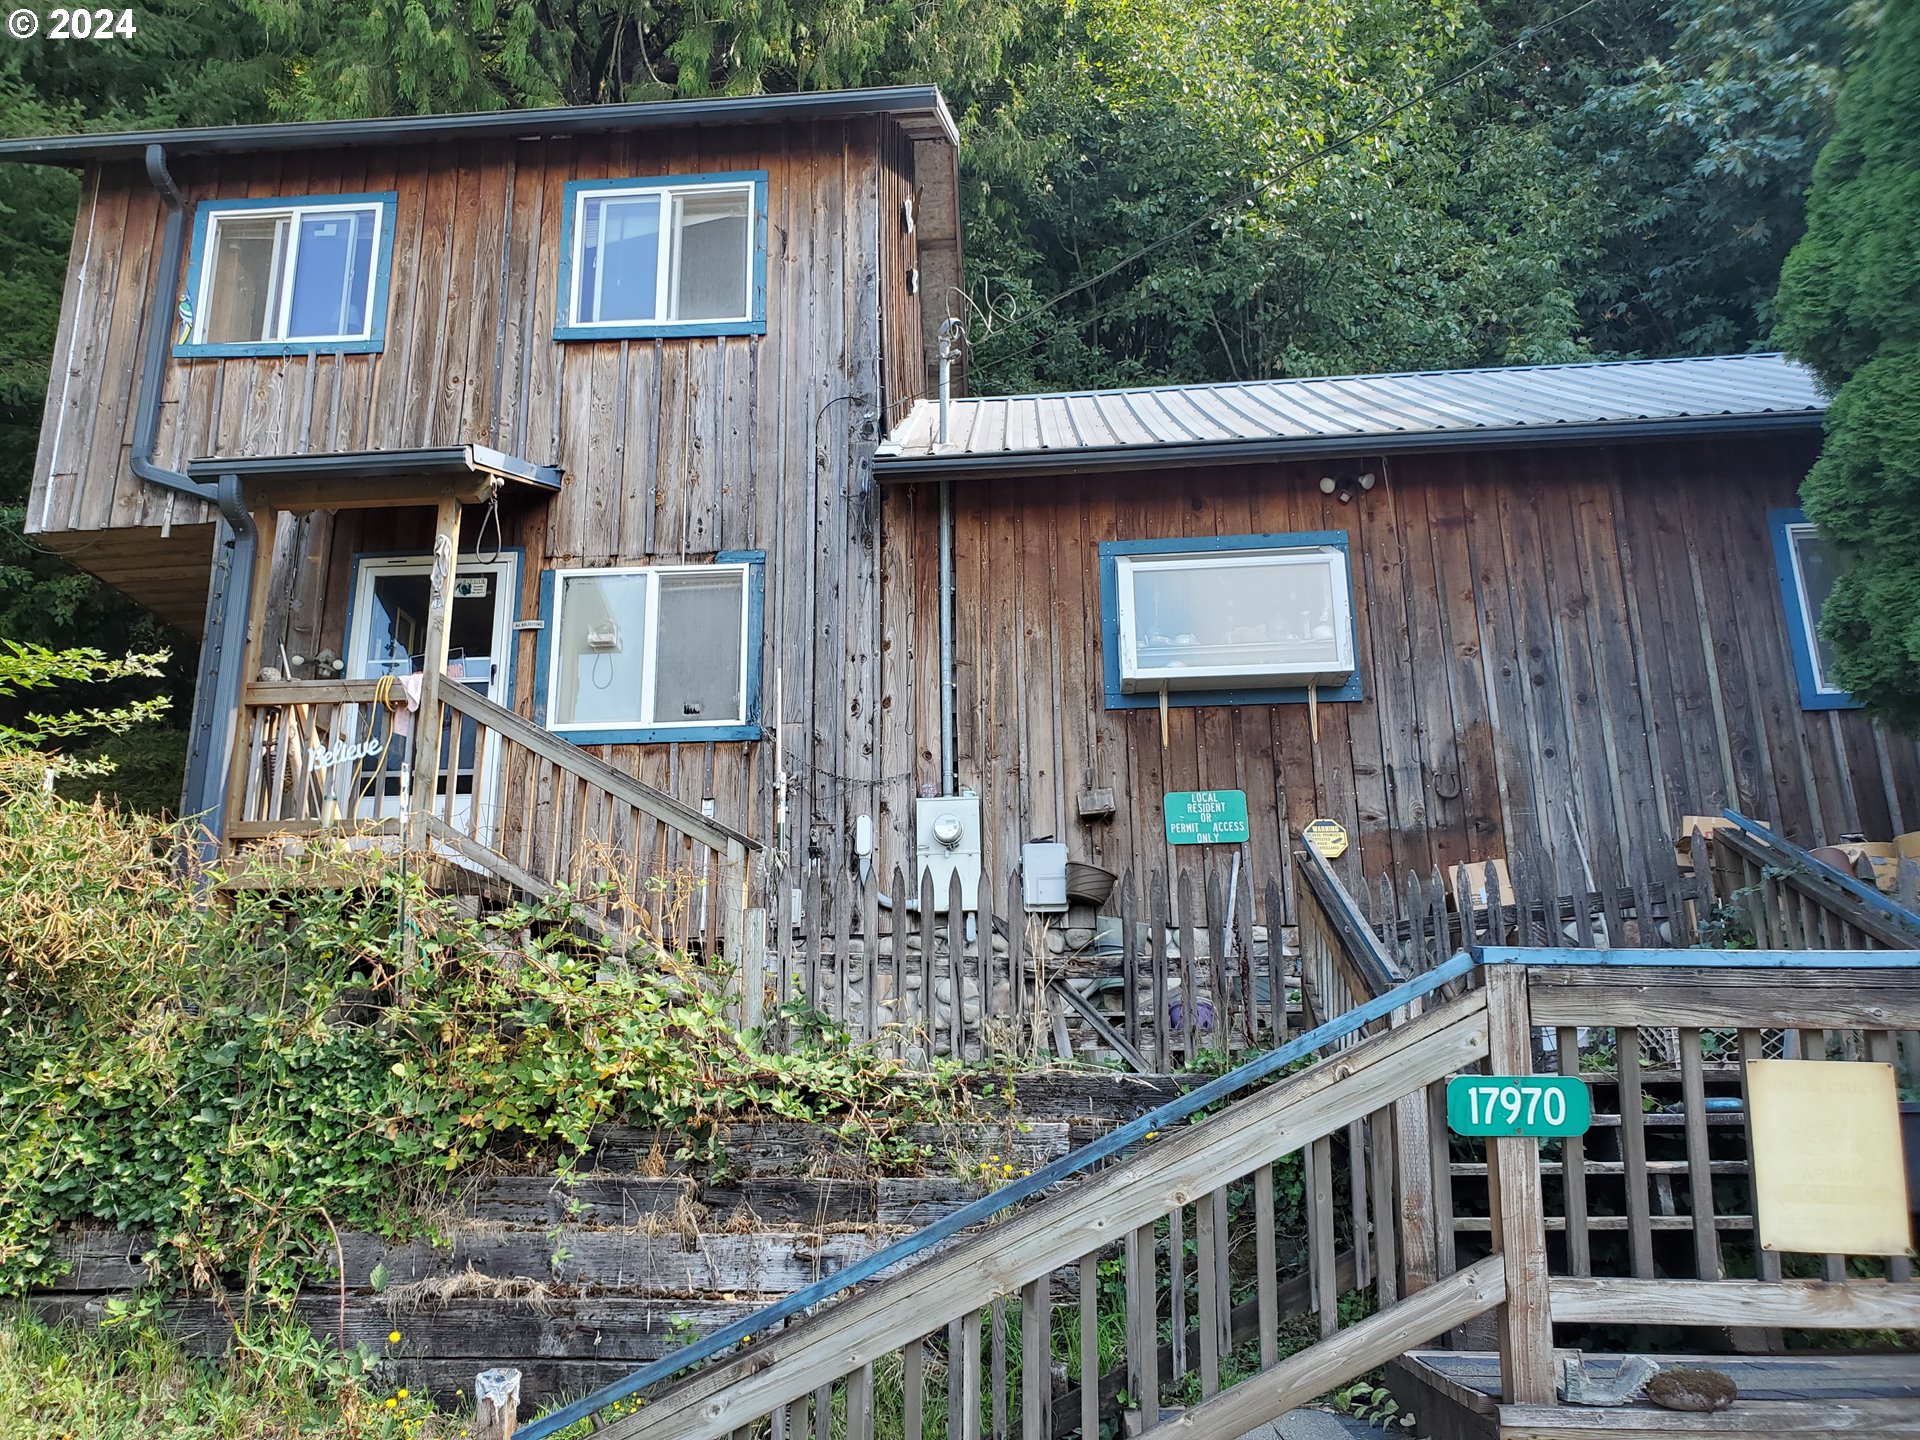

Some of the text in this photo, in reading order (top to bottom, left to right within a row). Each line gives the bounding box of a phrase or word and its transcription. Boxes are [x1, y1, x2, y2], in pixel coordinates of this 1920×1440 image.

[307, 736, 383, 772] Believe
[1191, 792, 1218, 803] LOCAL
[1187, 802, 1226, 813] RESIDENT
[1200, 812, 1212, 823] OR
[1170, 821, 1245, 833] PERMIT ACCESS
[1196, 833, 1220, 843] ONLY
[1468, 1087, 1566, 1126] 17970
